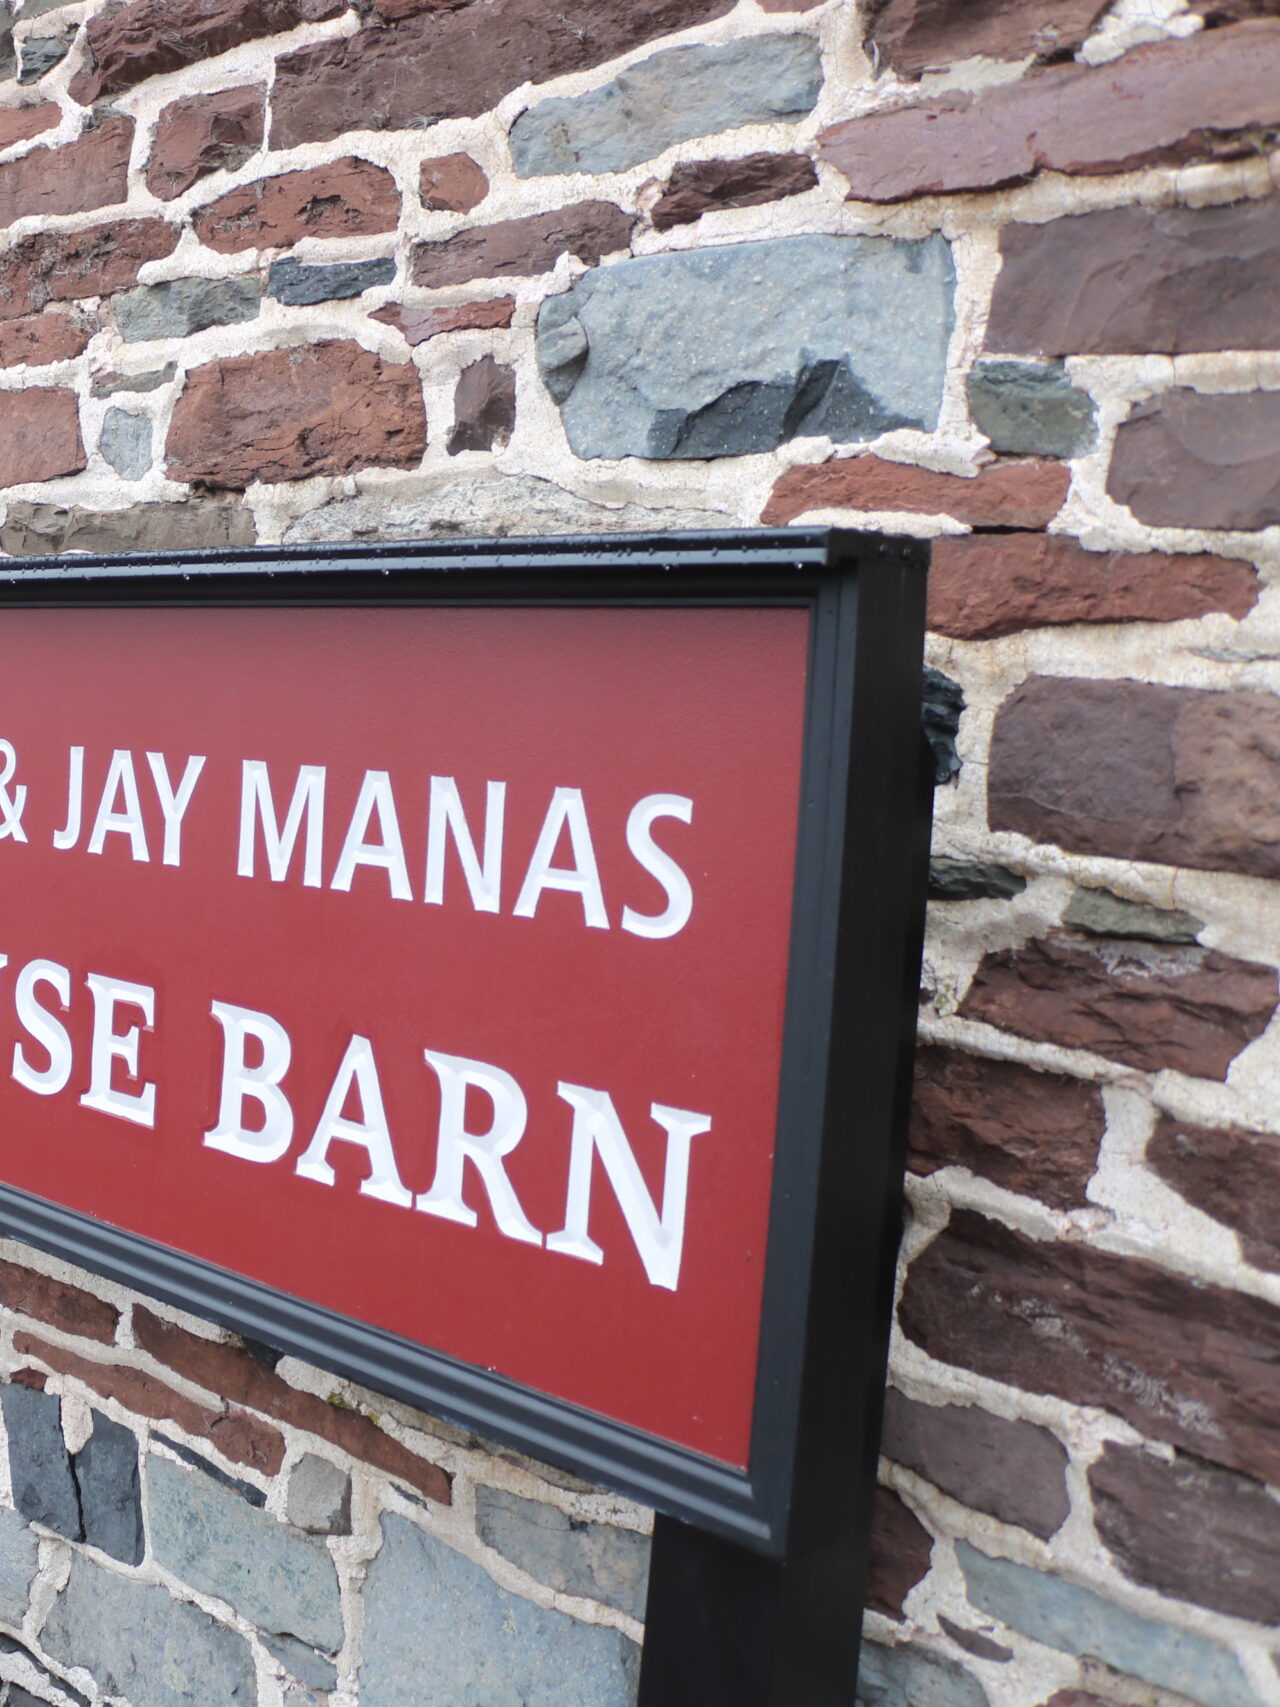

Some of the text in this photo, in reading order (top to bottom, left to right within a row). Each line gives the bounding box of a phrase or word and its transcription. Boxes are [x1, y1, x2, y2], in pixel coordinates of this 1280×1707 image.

[52, 745, 208, 868] JAY
[236, 759, 694, 940] MANAS
[202, 999, 713, 1292] BARN
